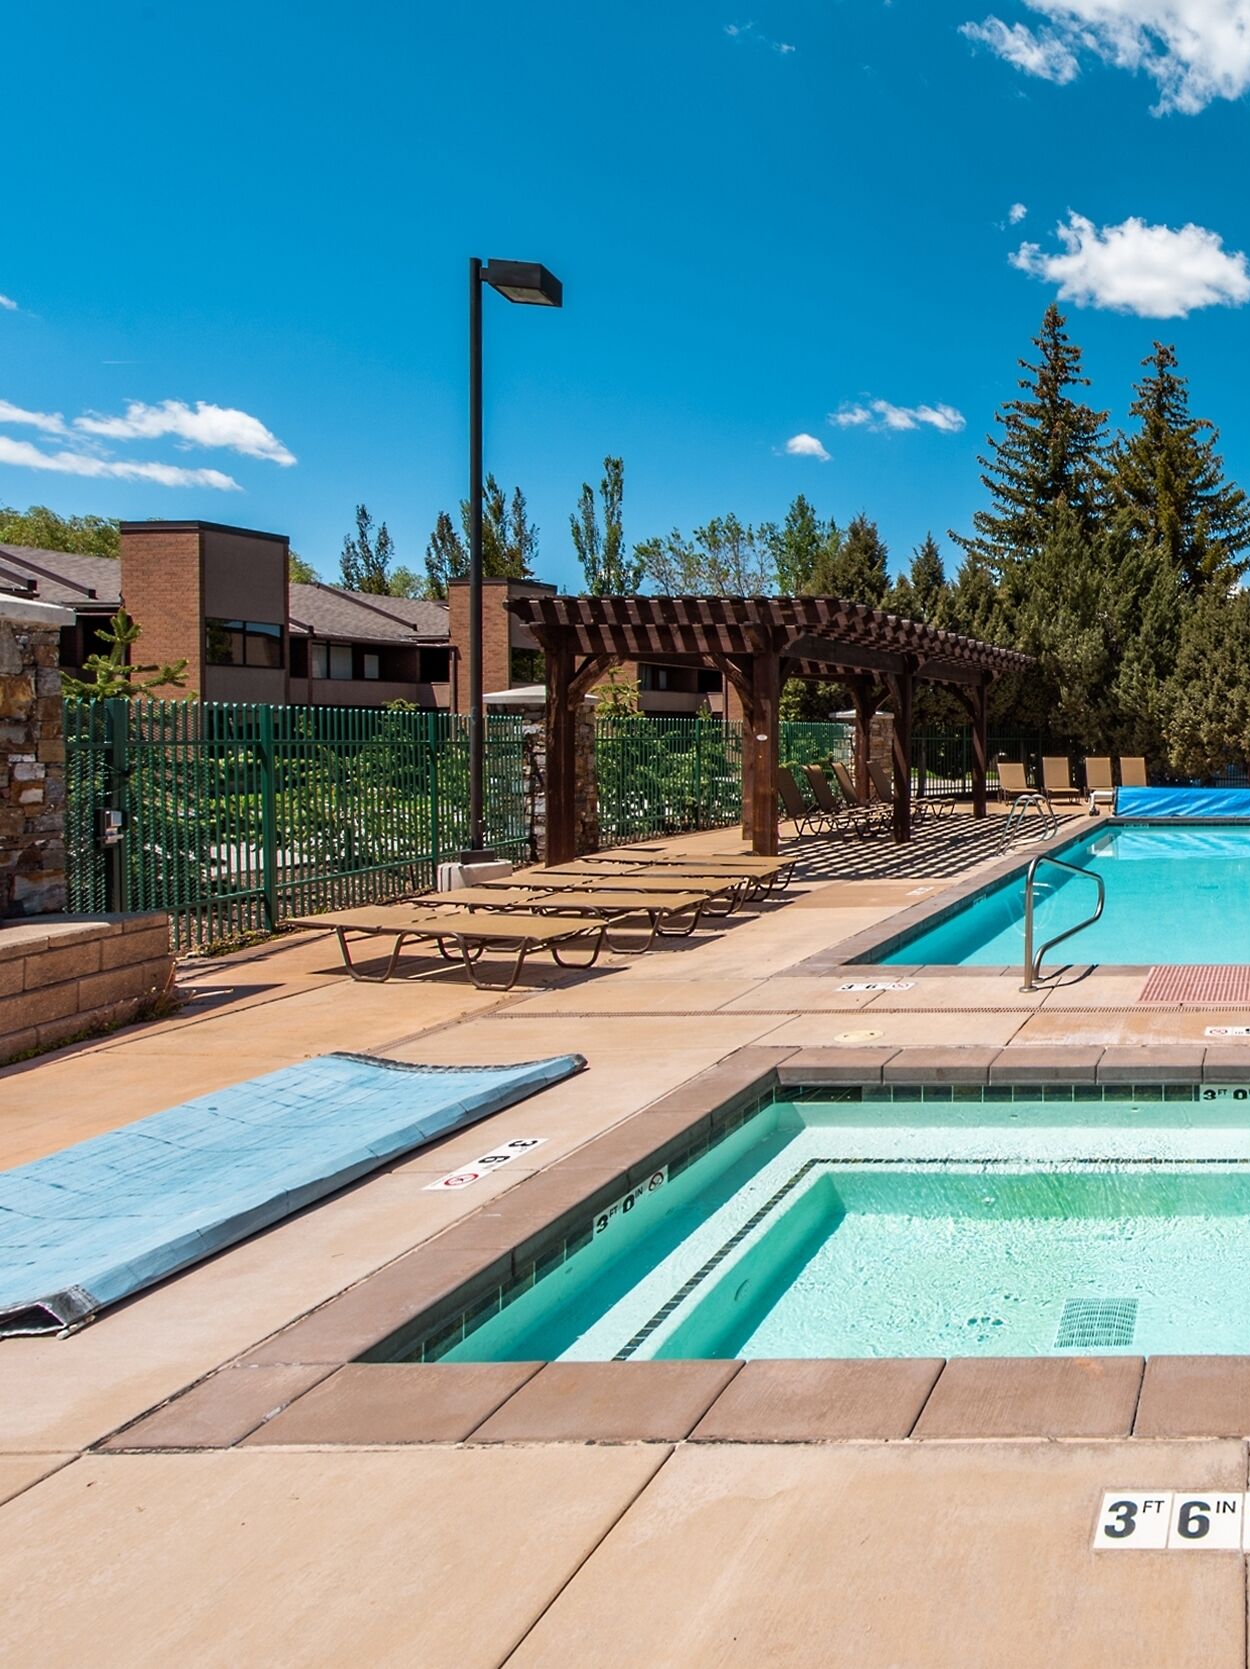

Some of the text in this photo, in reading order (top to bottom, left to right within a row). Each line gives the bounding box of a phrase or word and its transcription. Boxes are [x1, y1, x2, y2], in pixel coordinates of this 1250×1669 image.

[1203, 1089, 1216, 1100] 3
[1233, 1089, 1248, 1100] 0
[597, 1214, 608, 1234] 3
[609, 1205, 618, 1218] FT
[623, 1194, 635, 1214] 0
[1104, 1500, 1237, 1540] 3 FT 6 IN
